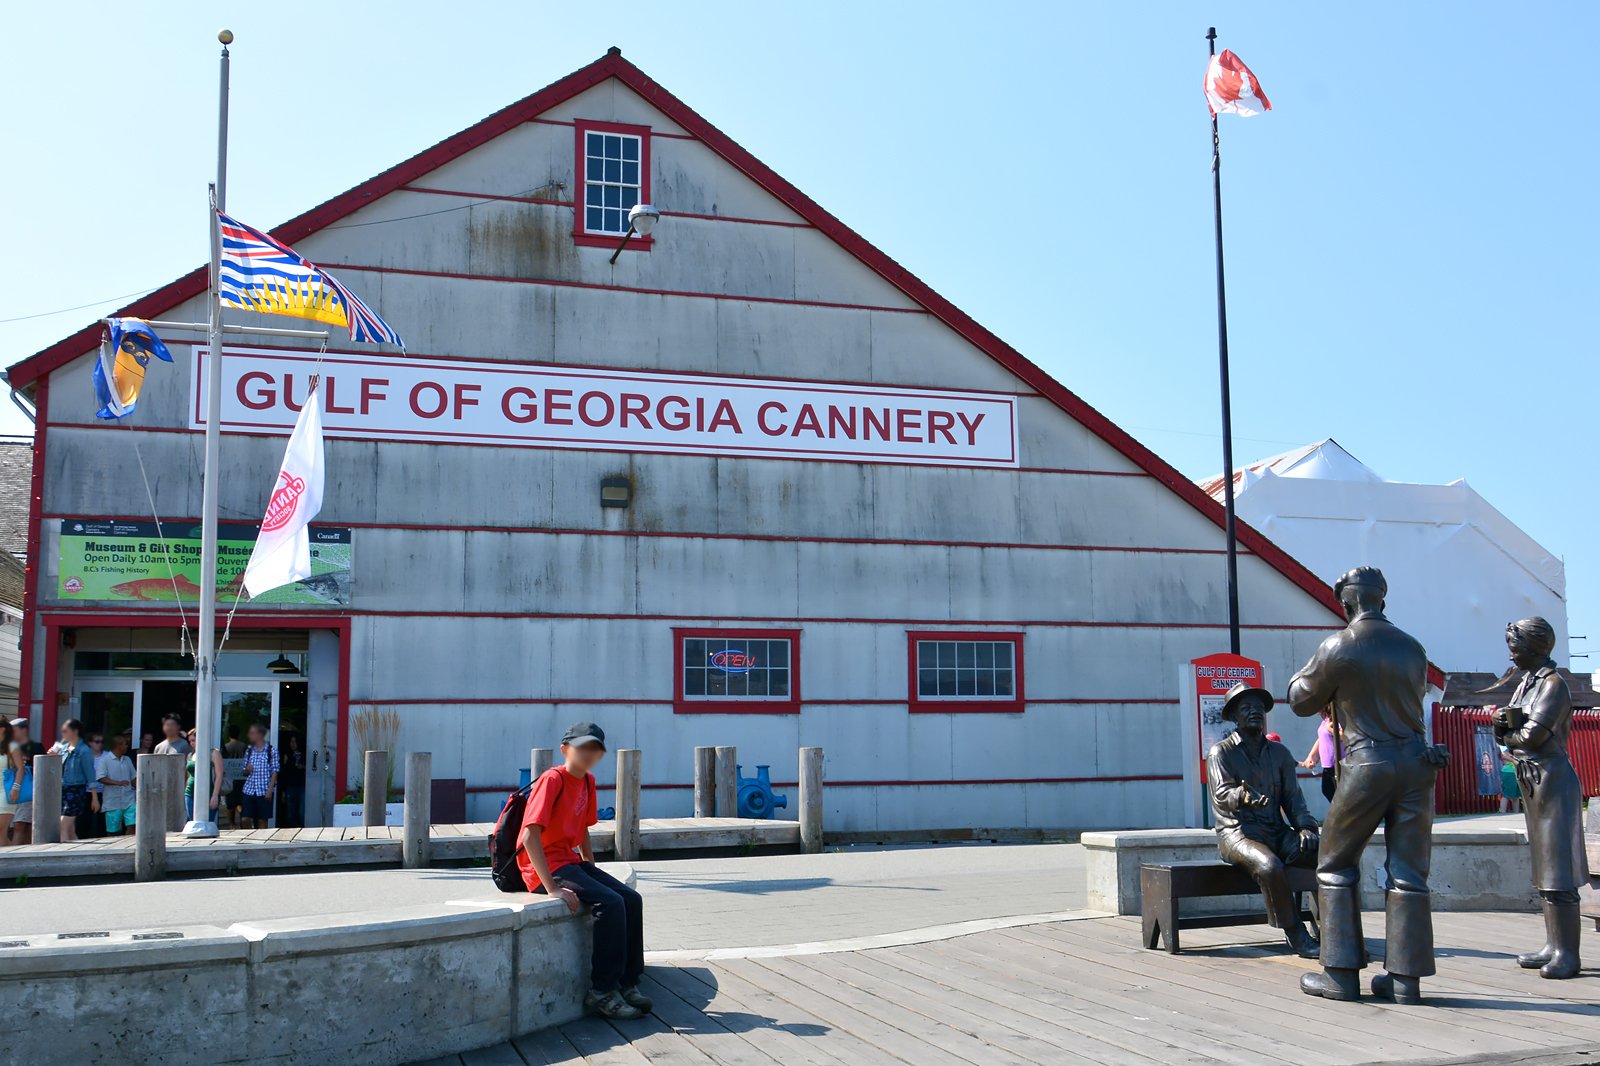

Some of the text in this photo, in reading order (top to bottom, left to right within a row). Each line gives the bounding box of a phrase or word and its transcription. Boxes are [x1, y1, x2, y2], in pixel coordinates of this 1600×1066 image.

[236, 371, 986, 446] GULF OF GEORGIA CANNERY
[85, 542, 202, 556] Museum & Gift Shop
[84, 553, 201, 566] Open Daily 10am to 5pm
[217, 556, 248, 566] Ouvert
[217, 566, 229, 575] de
[714, 653, 756, 667] OPEN
[1198, 667, 1255, 678] GULF OF GEORGIA
